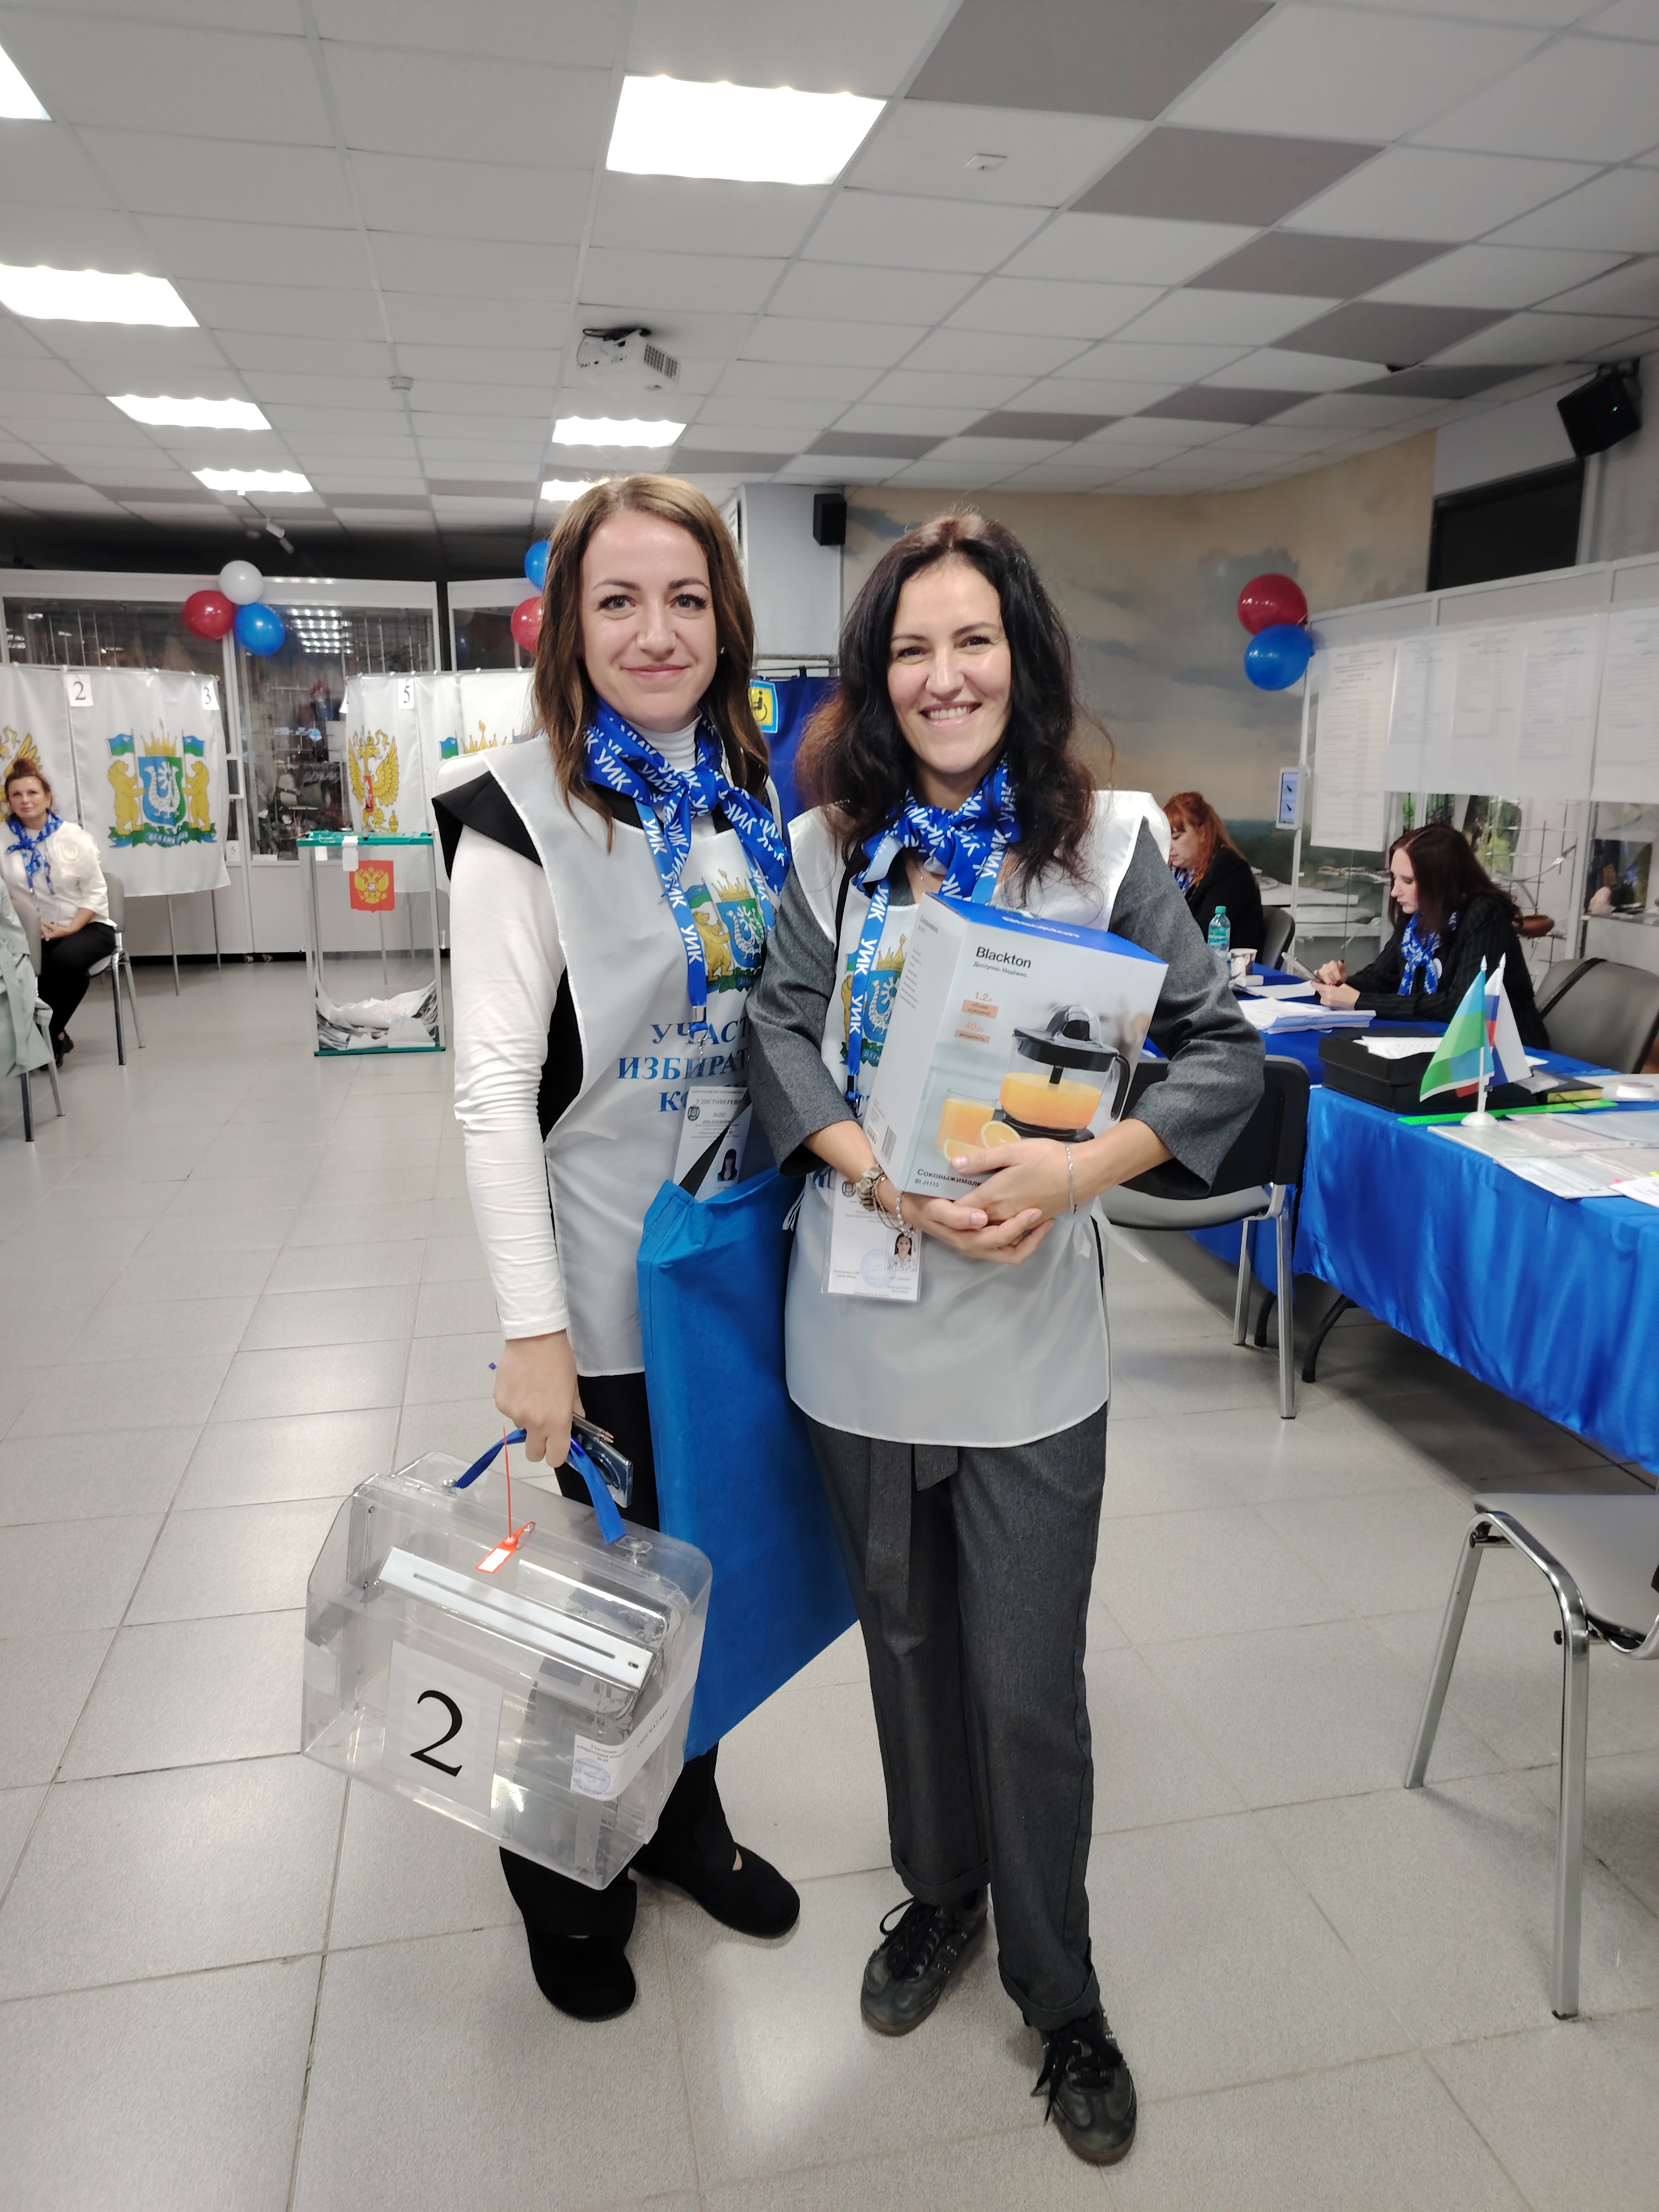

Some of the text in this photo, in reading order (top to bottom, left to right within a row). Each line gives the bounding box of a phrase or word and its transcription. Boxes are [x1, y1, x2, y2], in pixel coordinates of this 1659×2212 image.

[73, 681, 86, 701] 2
[204, 686, 212, 705] 3
[403, 685, 410, 704] 5
[594, 747, 632, 792] УИК
[667, 817, 690, 847] УИК
[724, 800, 758, 835] УИК
[643, 818, 668, 855] УИК
[750, 867, 769, 901] УИК
[868, 884, 889, 923] УИК
[681, 924, 703, 965] УИК
[854, 938, 878, 976] УИК
[975, 946, 1032, 969] Blackton
[973, 961, 1001, 972] Доступно.
[849, 994, 863, 1035] УИК
[959, 1032, 985, 1042] мощность
[616, 1047, 748, 1080] ИЗБИРАТ
[917, 1168, 983, 1187] Соковыжималк
[410, 1690, 462, 1777] 2
